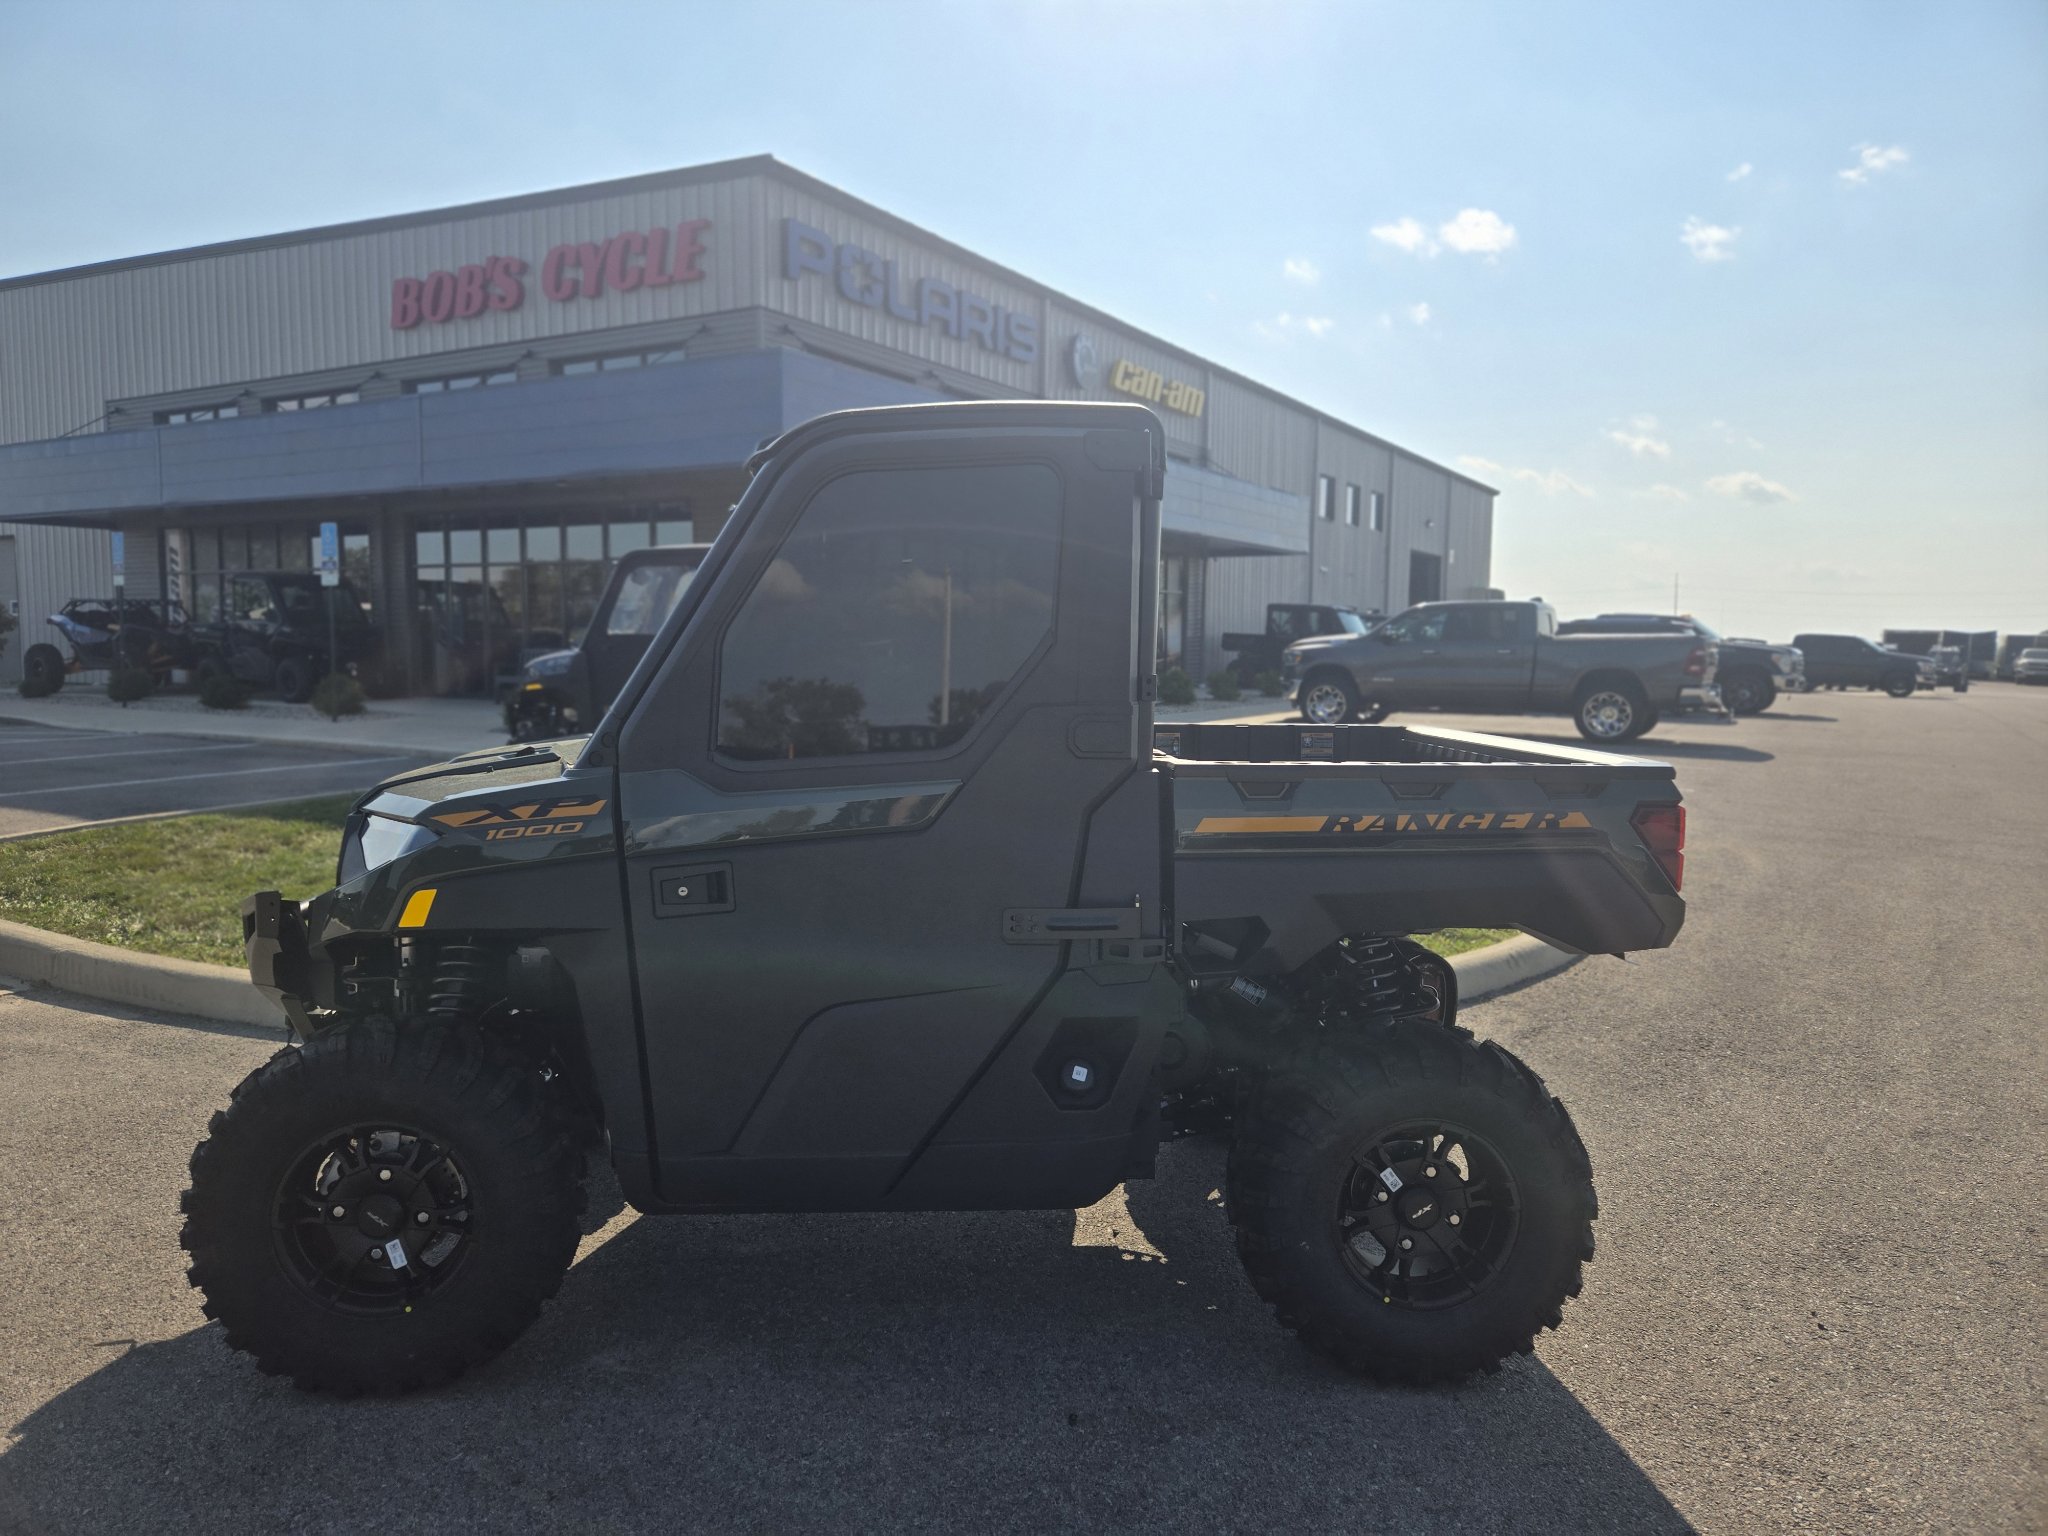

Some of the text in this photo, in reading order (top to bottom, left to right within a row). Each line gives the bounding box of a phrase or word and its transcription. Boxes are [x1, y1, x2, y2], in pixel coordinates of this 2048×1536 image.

[391, 218, 711, 330] BOB'S CYCLE
[781, 216, 1040, 363] POLARIS
[1110, 359, 1205, 418] can-am
[460, 796, 596, 825] XP
[486, 821, 584, 841] 1000
[1321, 812, 1565, 832] RANGER
